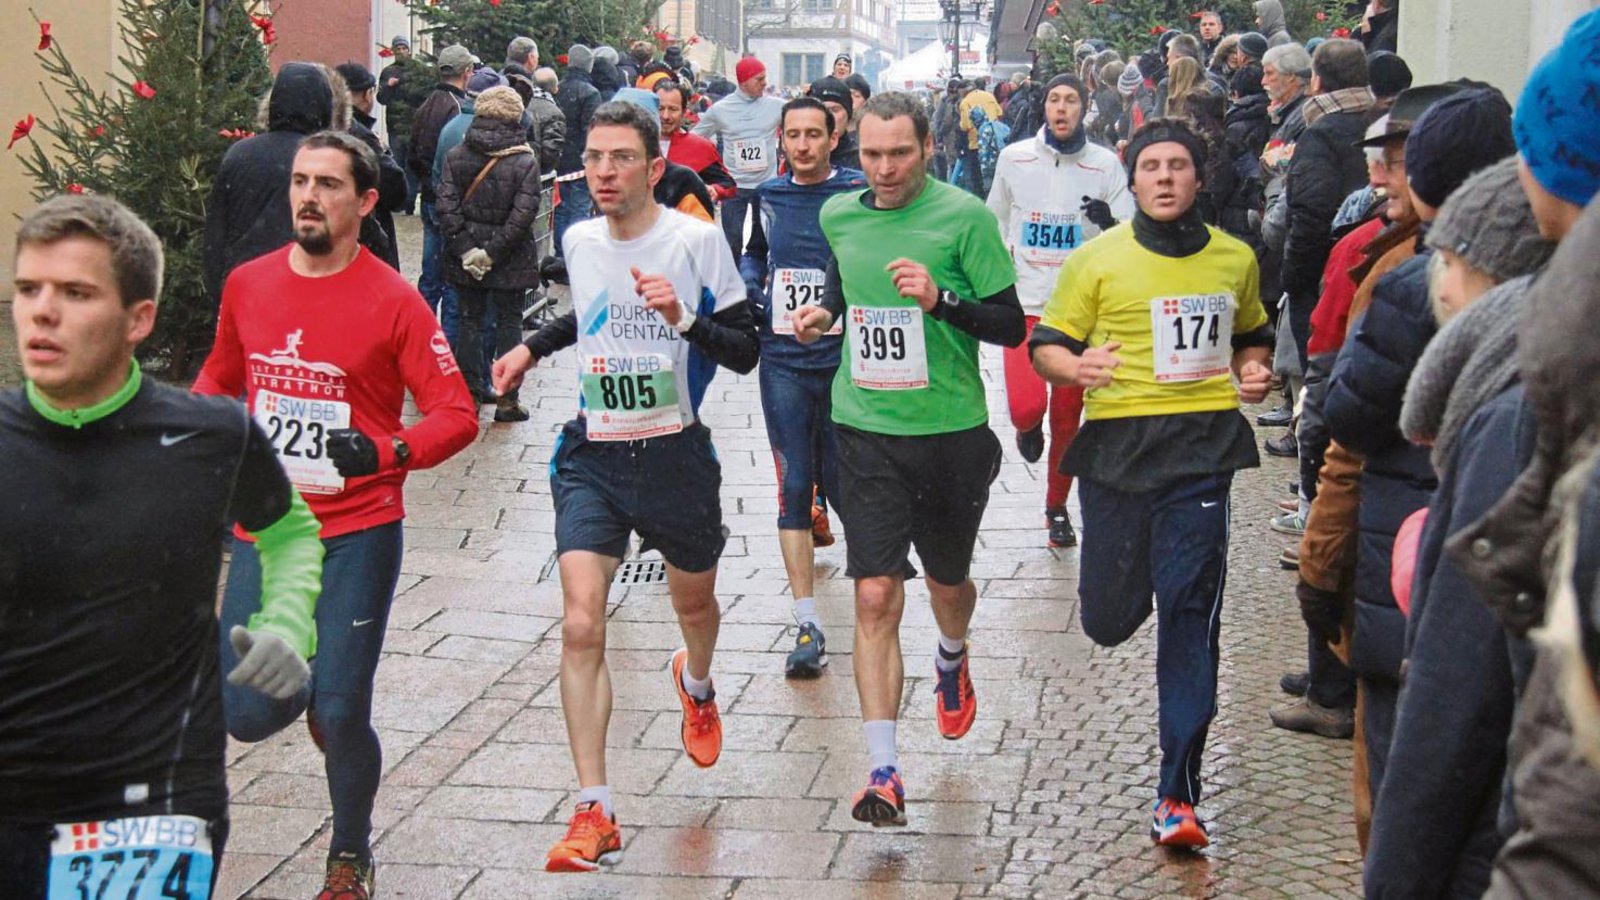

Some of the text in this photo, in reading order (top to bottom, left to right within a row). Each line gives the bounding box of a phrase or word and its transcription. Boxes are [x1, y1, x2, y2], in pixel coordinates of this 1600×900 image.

[741, 146, 761, 161] 422
[1027, 223, 1075, 249] 3544
[792, 271, 812, 284] SW
[610, 300, 658, 322] DÜRR
[864, 309, 886, 325] SW
[1181, 298, 1205, 314] SW
[610, 322, 679, 341] DENTAL
[1173, 314, 1220, 350] 174
[860, 325, 906, 361] 399
[607, 357, 633, 374] SW
[600, 374, 657, 411] 805
[279, 398, 306, 418] SW
[267, 415, 324, 460] 223
[103, 817, 149, 847] SW
[69, 849, 194, 900] 3774
